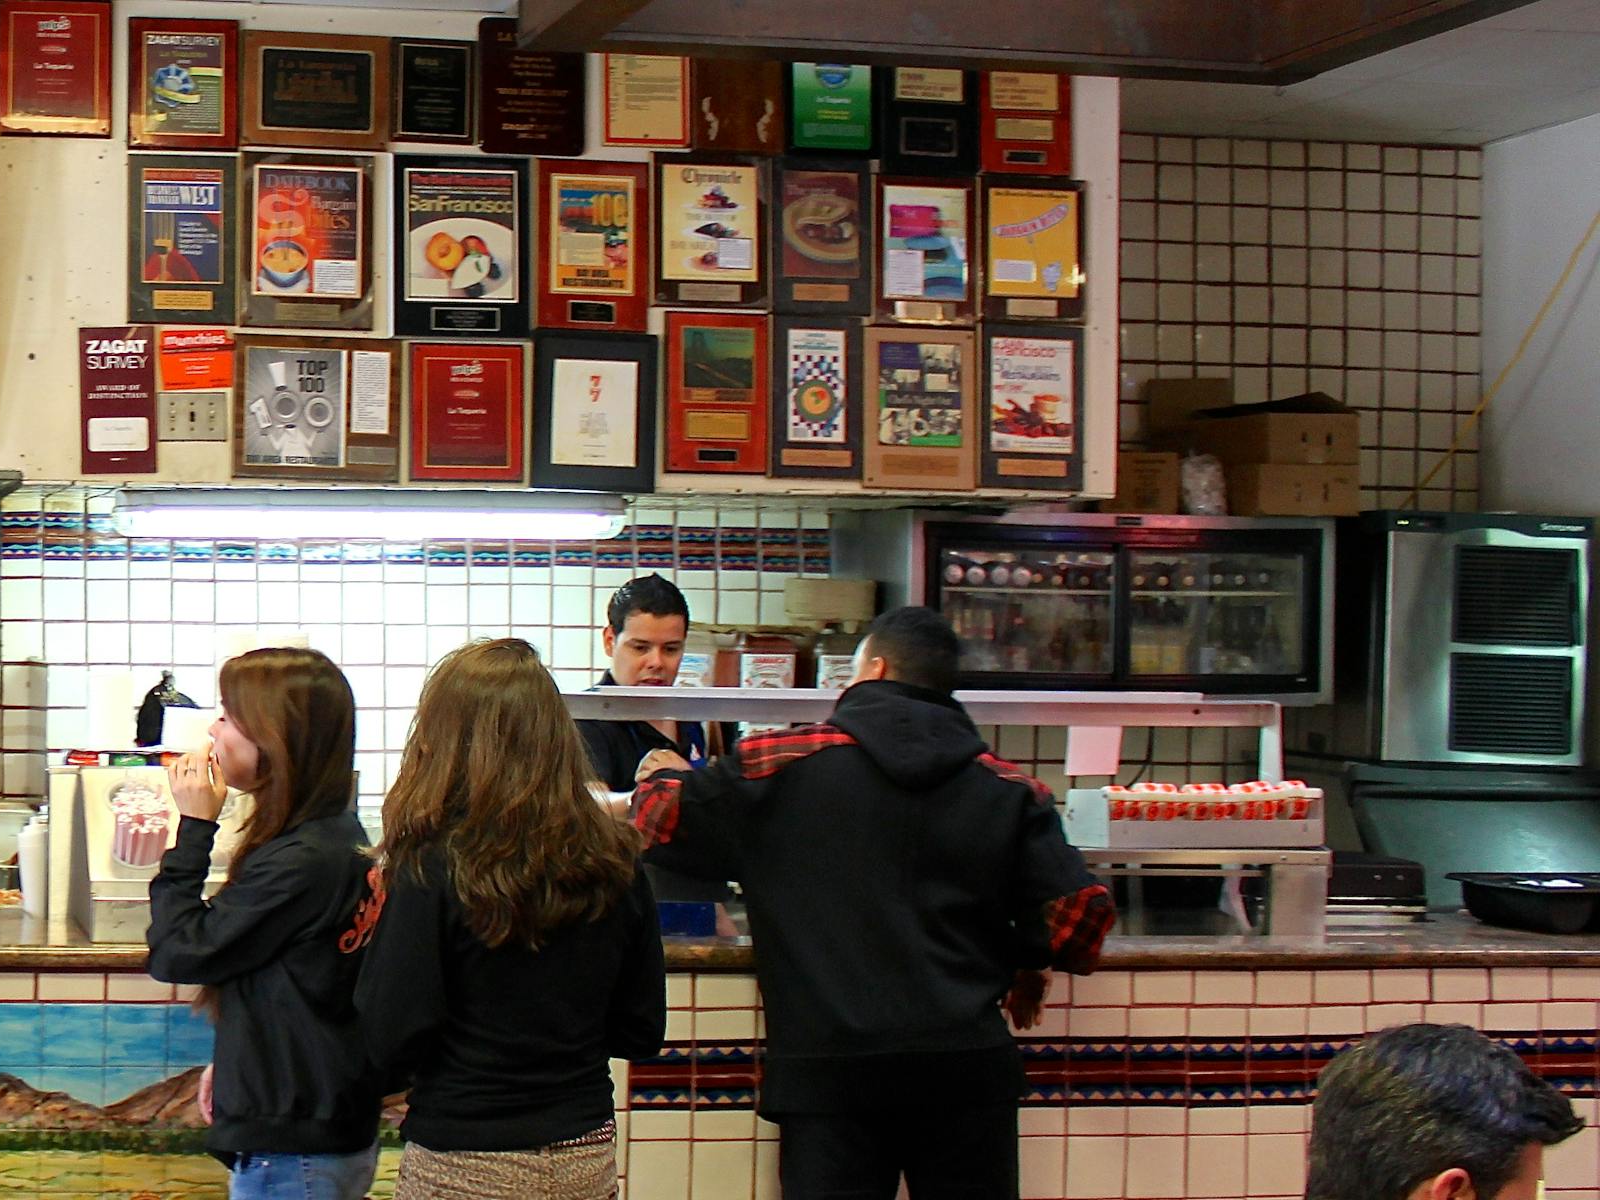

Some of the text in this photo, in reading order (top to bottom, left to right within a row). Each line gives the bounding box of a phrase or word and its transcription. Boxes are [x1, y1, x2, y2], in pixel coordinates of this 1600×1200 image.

[85, 339, 148, 354] ZAGAT
[86, 355, 149, 370] SURVEY
[296, 360, 329, 376] TOP
[298, 377, 326, 393] 100
